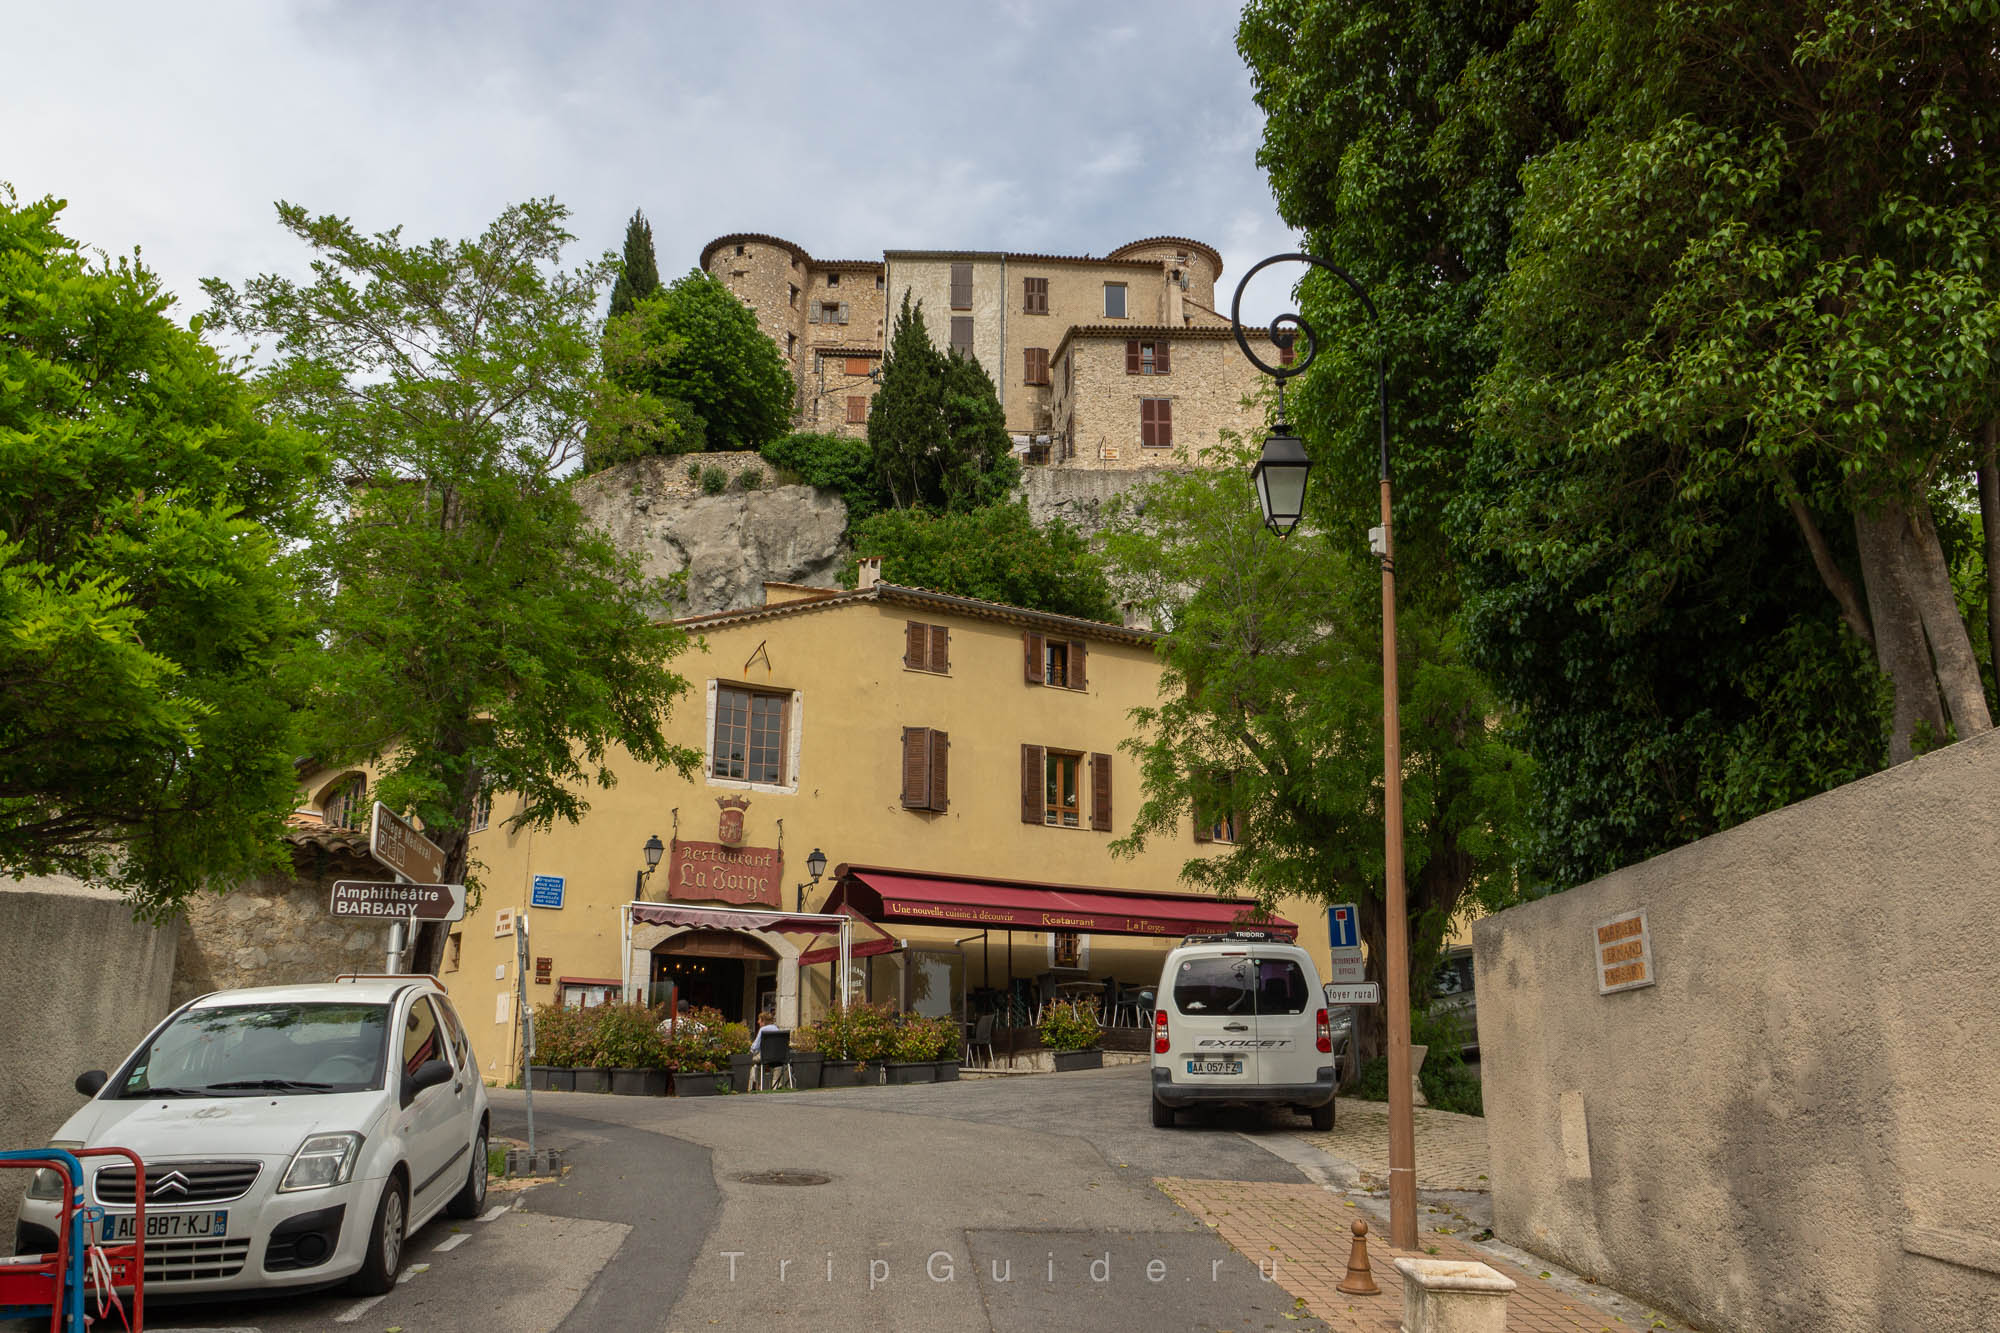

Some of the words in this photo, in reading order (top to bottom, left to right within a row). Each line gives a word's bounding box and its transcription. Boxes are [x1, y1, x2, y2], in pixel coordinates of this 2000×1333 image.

[681, 846, 772, 867] Restaurant
[680, 863, 707, 888] La
[336, 885, 440, 901] Amphithéâtre
[336, 901, 419, 915] BARBARY
[892, 903, 911, 913] Une
[912, 906, 944, 917] nouvelle
[945, 908, 971, 919] cuisine
[979, 910, 1014, 921] découvrir
[1041, 913, 1095, 926] Restaurant
[1126, 919, 1139, 931] La
[1141, 920, 1166, 934] Forge
[1329, 989, 1350, 1001] foyer
[1354, 986, 1375, 999] rural
[1198, 1039, 1292, 1047] EXOCET
